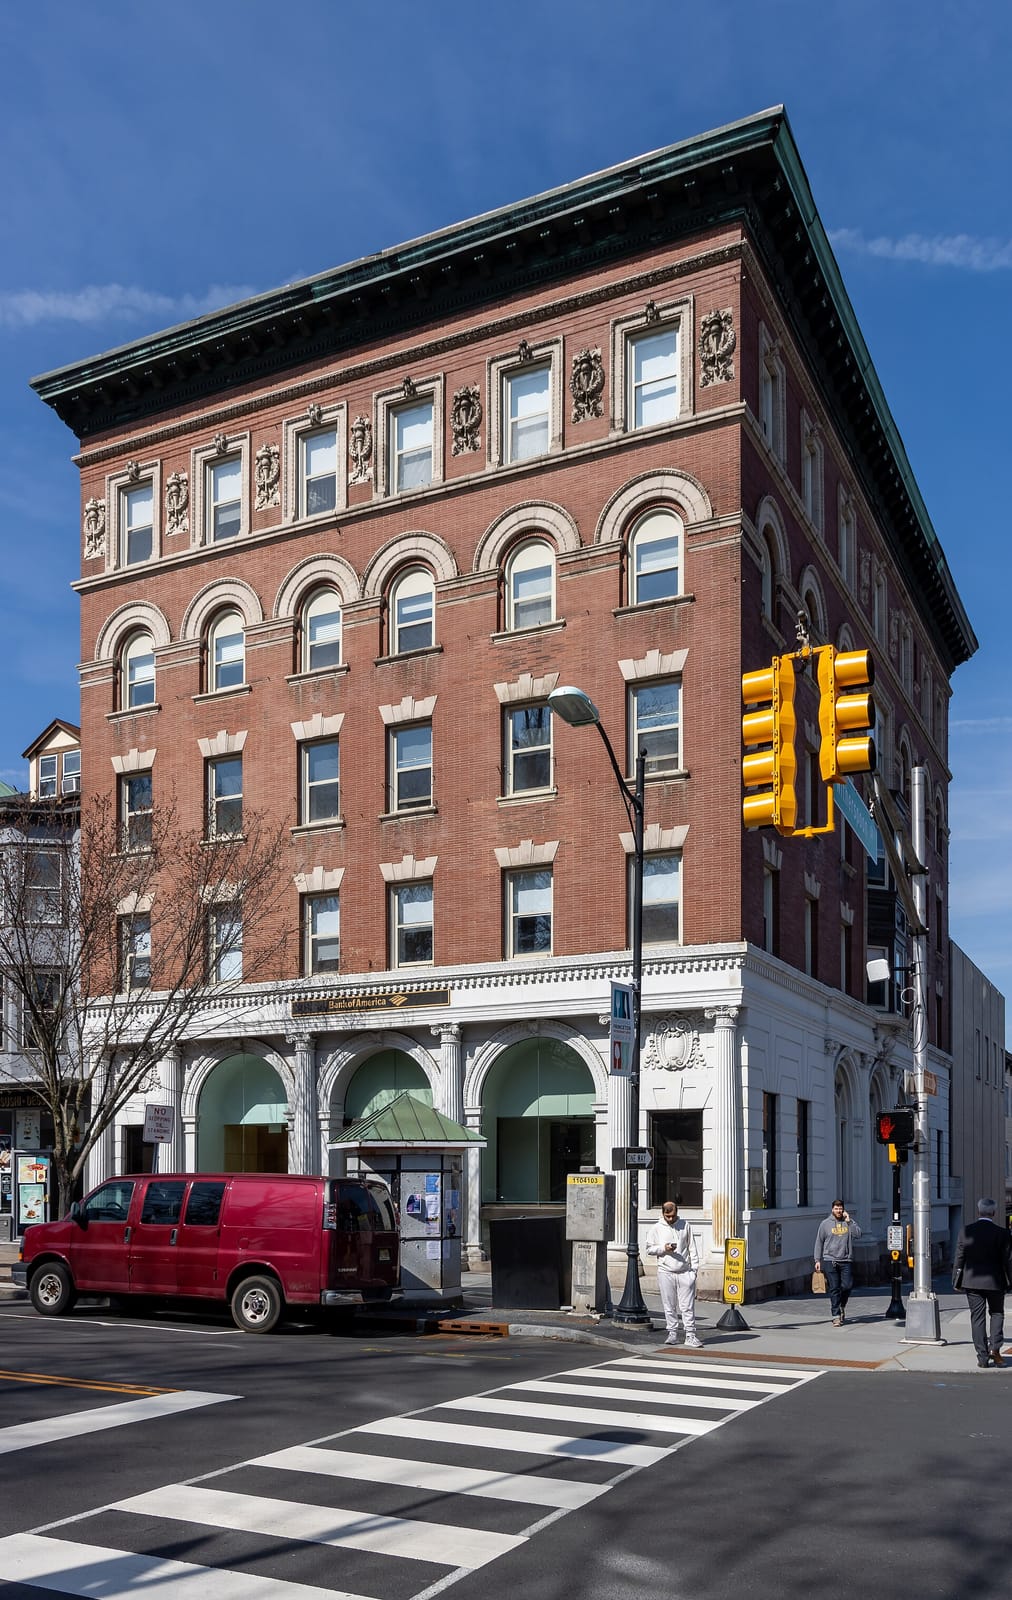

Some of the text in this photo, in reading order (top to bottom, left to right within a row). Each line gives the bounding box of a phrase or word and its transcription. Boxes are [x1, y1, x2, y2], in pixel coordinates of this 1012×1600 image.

[329, 997, 387, 1009] Bank of America
[154, 1107, 166, 1116] NO
[573, 1176, 598, 1184] 1104103
